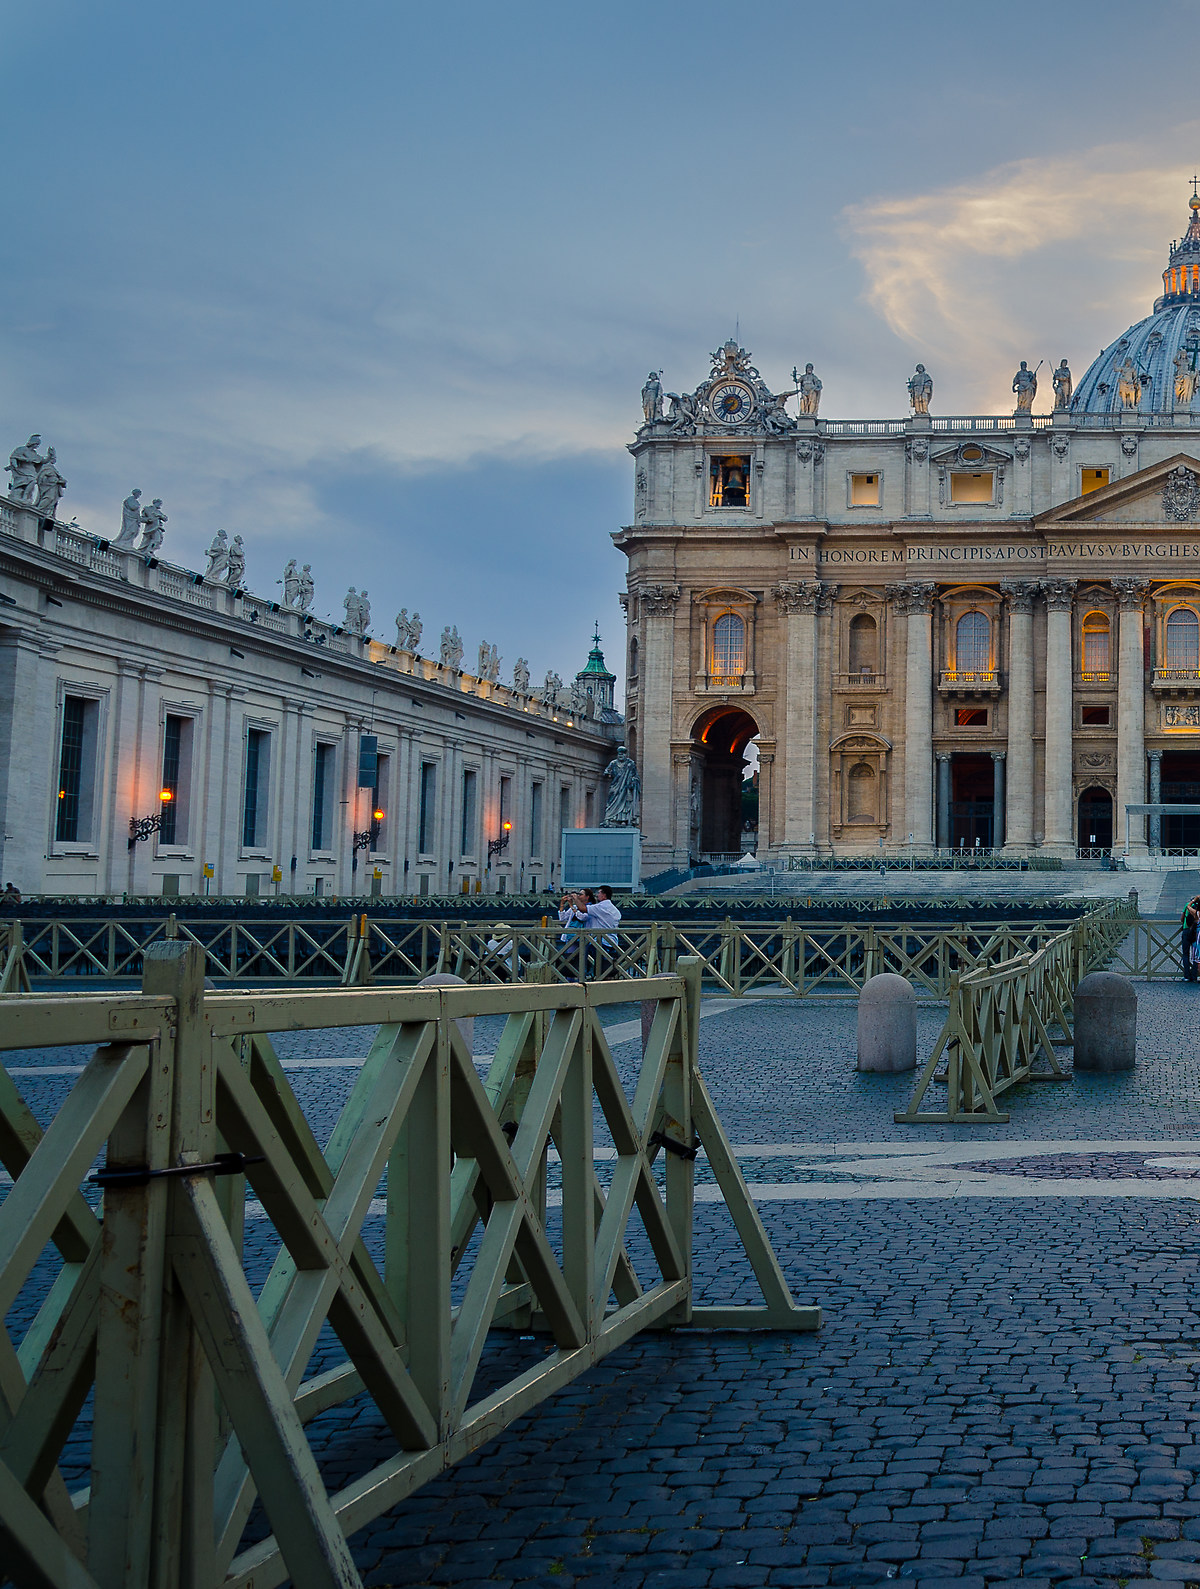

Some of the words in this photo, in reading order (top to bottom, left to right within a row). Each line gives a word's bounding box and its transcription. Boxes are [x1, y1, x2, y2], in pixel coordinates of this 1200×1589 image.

[789, 548, 810, 560] IN
[819, 550, 904, 562] HONOREM
[907, 547, 993, 560] PRINCIPIS
[995, 546, 1048, 559] APOST
[1048, 544, 1105, 556] PAVLVS
[1107, 544, 1118, 556] V
